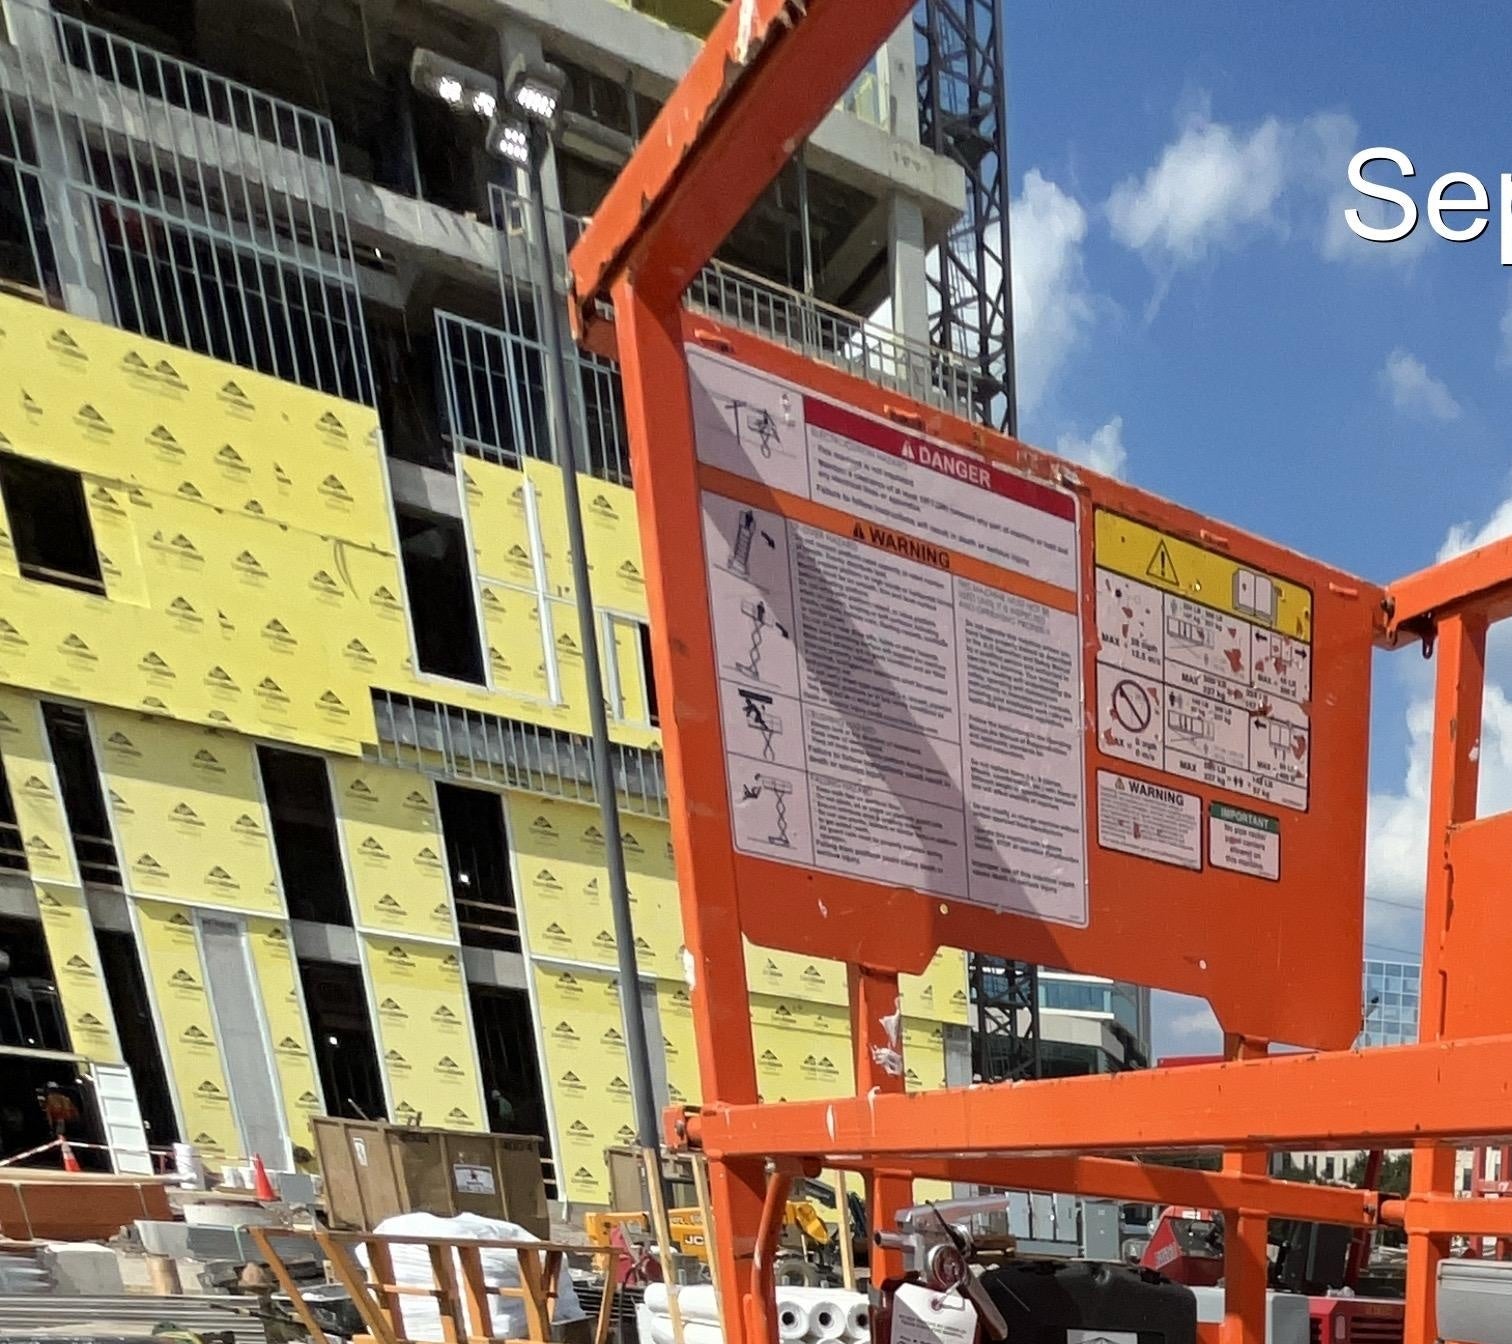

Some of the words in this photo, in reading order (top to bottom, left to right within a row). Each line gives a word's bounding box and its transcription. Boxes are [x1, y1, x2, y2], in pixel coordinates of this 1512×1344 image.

[919, 446, 992, 488] DANGER
[869, 525, 951, 570] WARNING
[1127, 780, 1185, 807] WARNING
[1221, 807, 1269, 830] IMPORTANT
